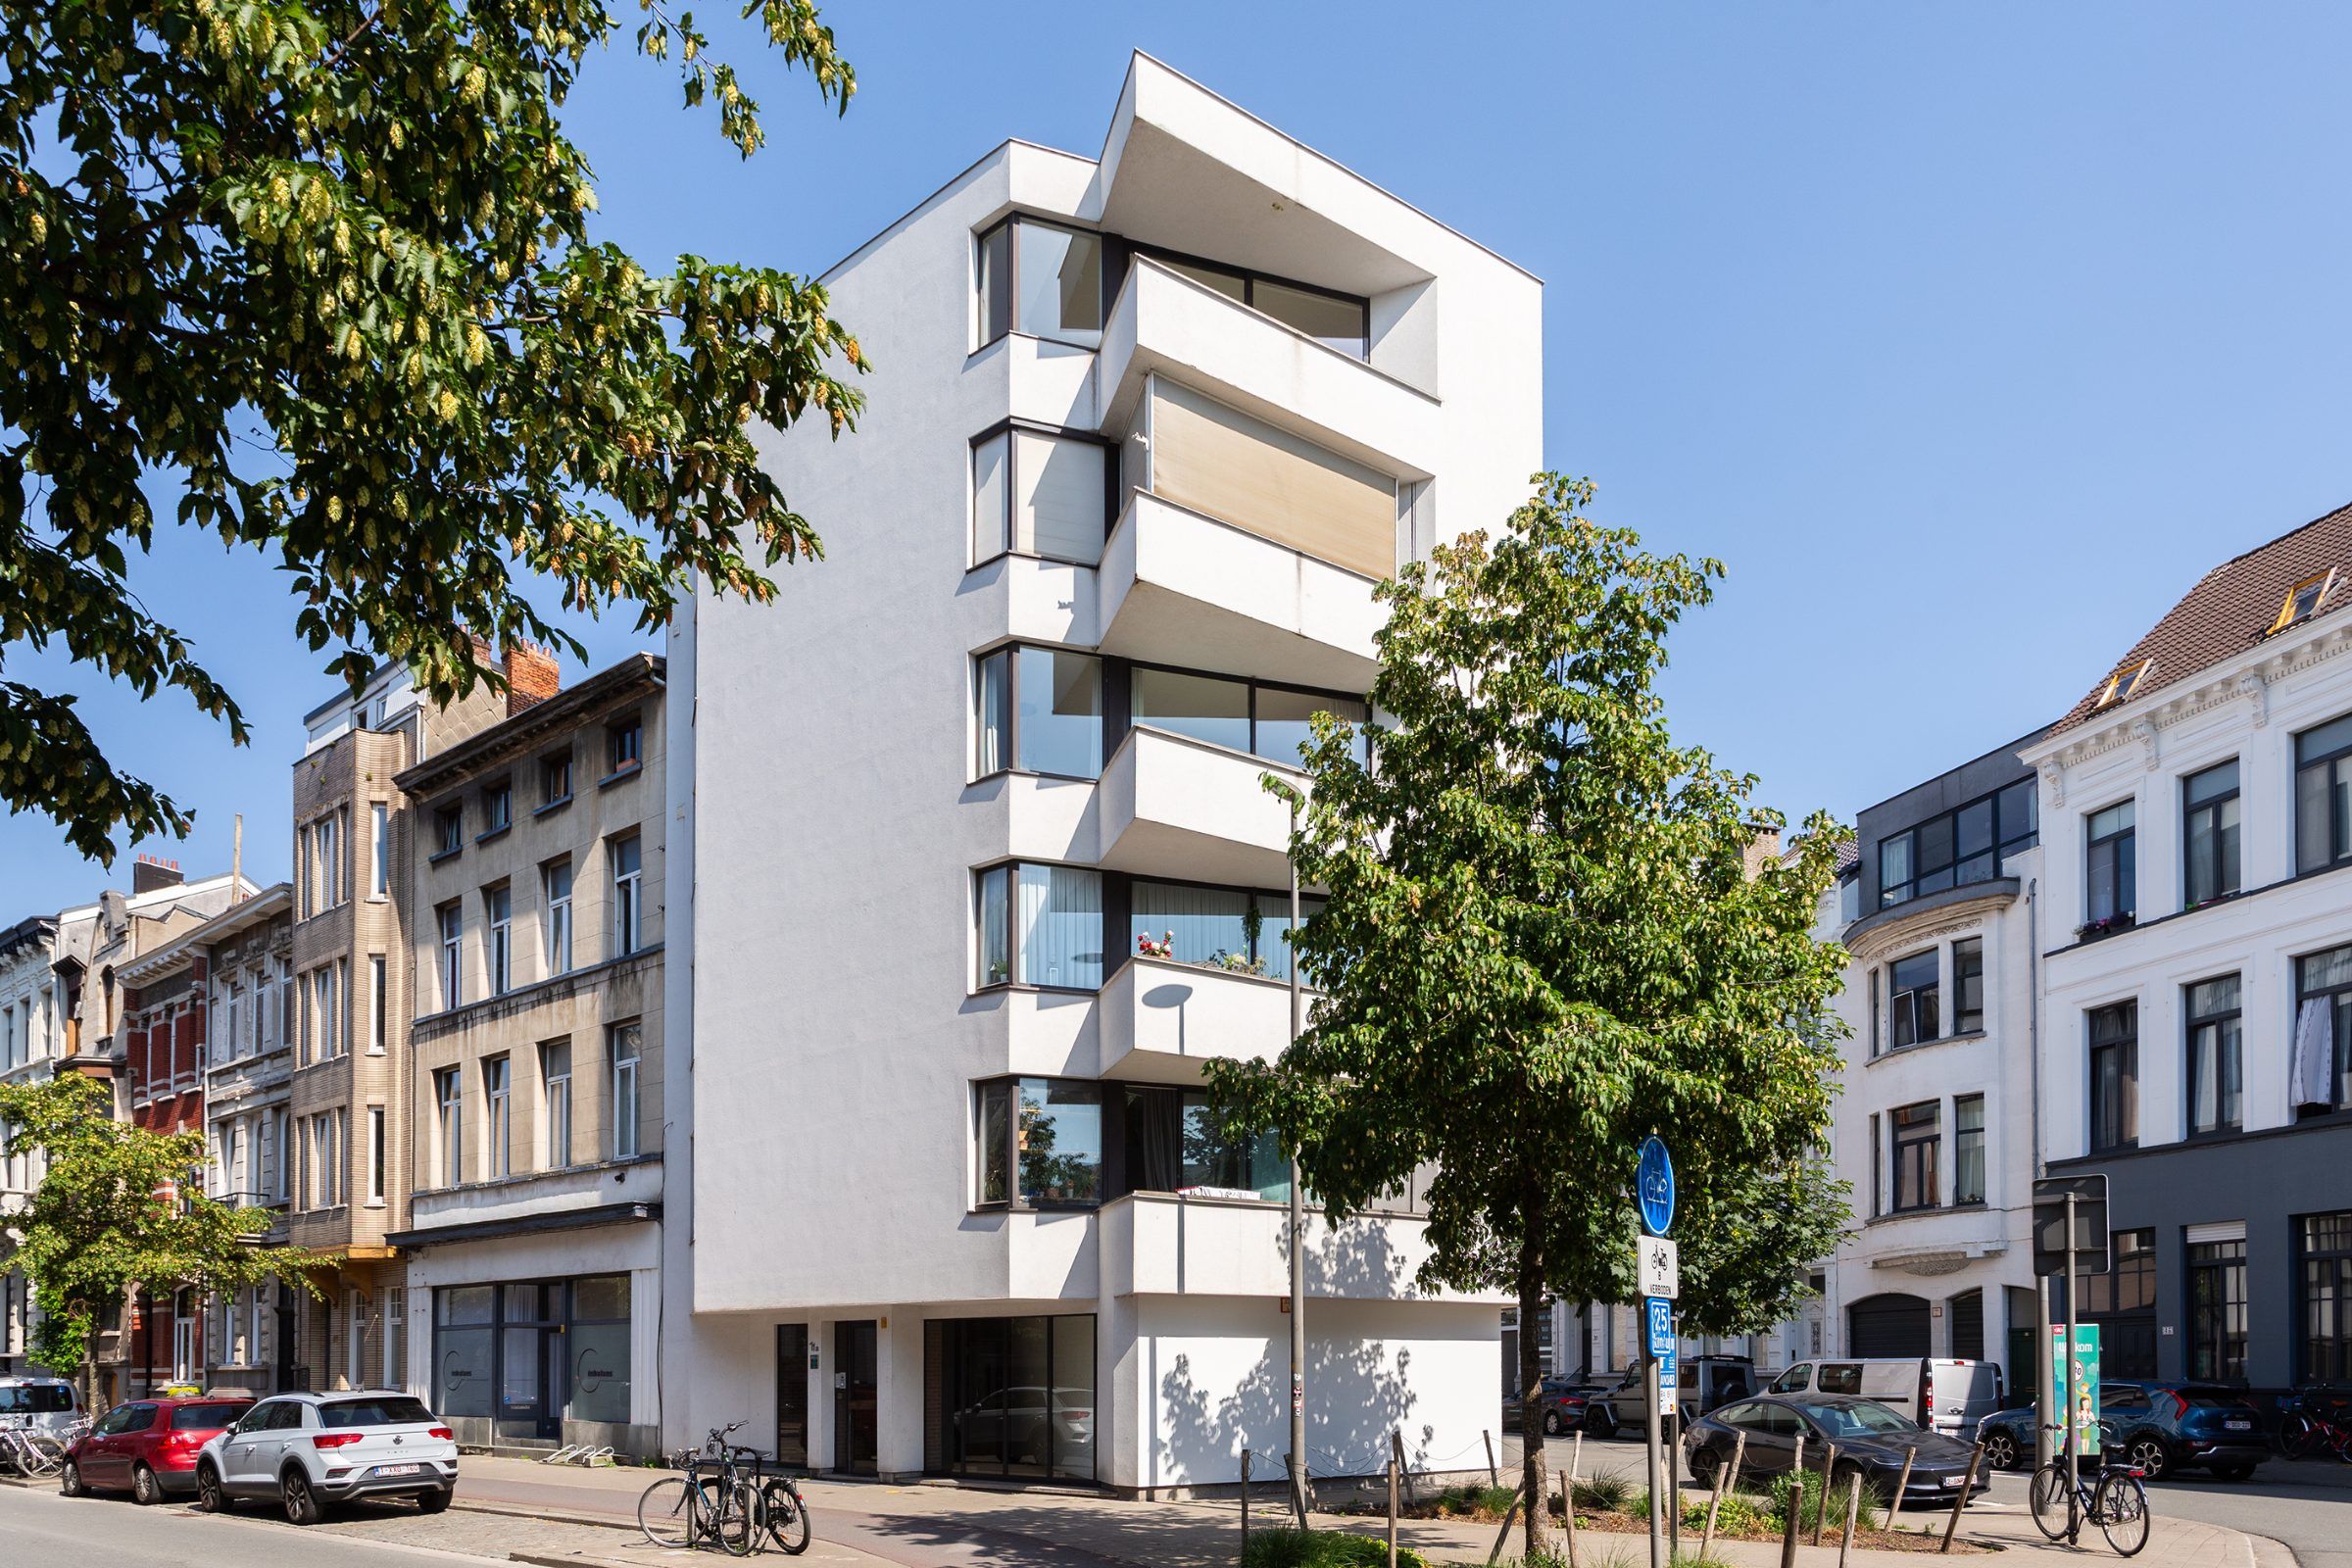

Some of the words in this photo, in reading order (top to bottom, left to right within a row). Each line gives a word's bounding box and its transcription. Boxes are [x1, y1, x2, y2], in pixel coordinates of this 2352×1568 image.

[1649, 1284, 1672, 1295] VERBODEN
[1654, 1307, 1668, 1332] 25
[2058, 1342, 2093, 1352] Wkom
